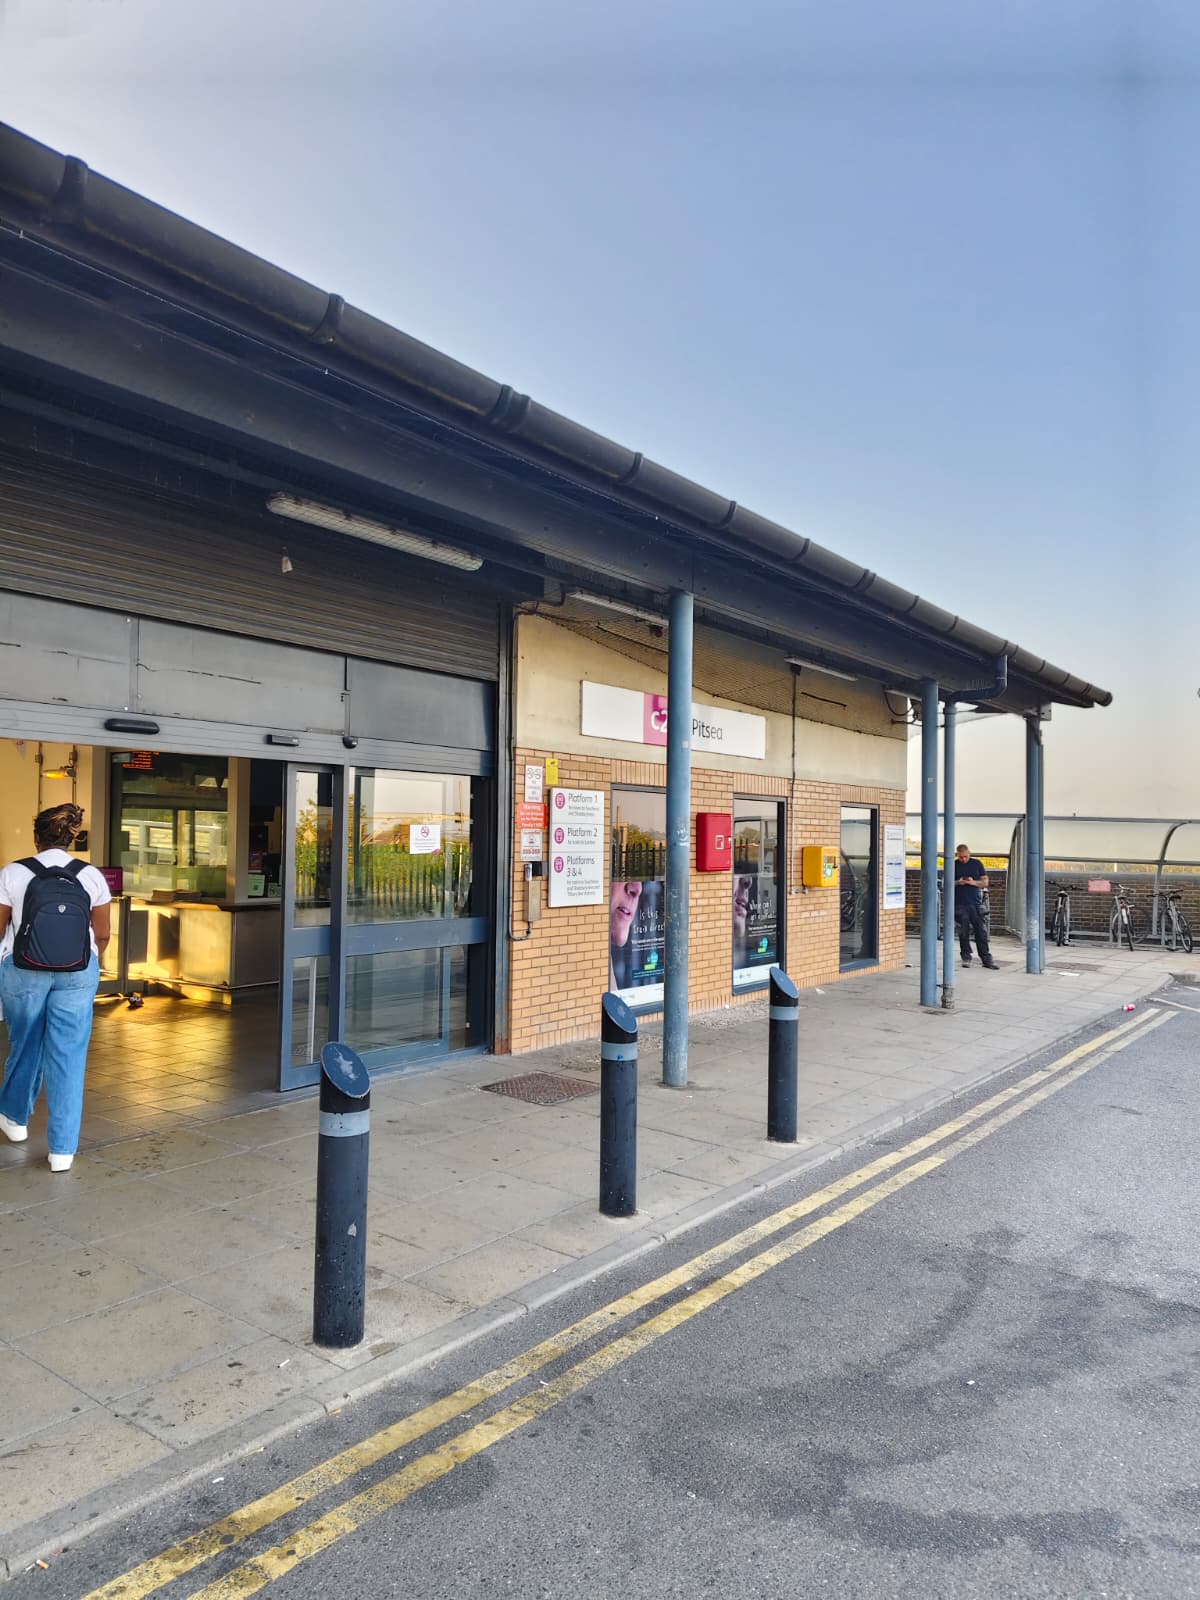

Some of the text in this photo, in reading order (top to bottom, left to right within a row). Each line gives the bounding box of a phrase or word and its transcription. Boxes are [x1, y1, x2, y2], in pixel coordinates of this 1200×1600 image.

[651, 709, 668, 733] c2
[692, 718, 723, 740] Pitsea
[568, 793, 592, 803] Platform
[567, 827, 598, 837] Platform 2
[566, 855, 595, 865] Platforms
[566, 867, 571, 877] 3
[572, 867, 577, 877] &
[639, 905, 659, 921] Is this
[633, 923, 648, 934] train
